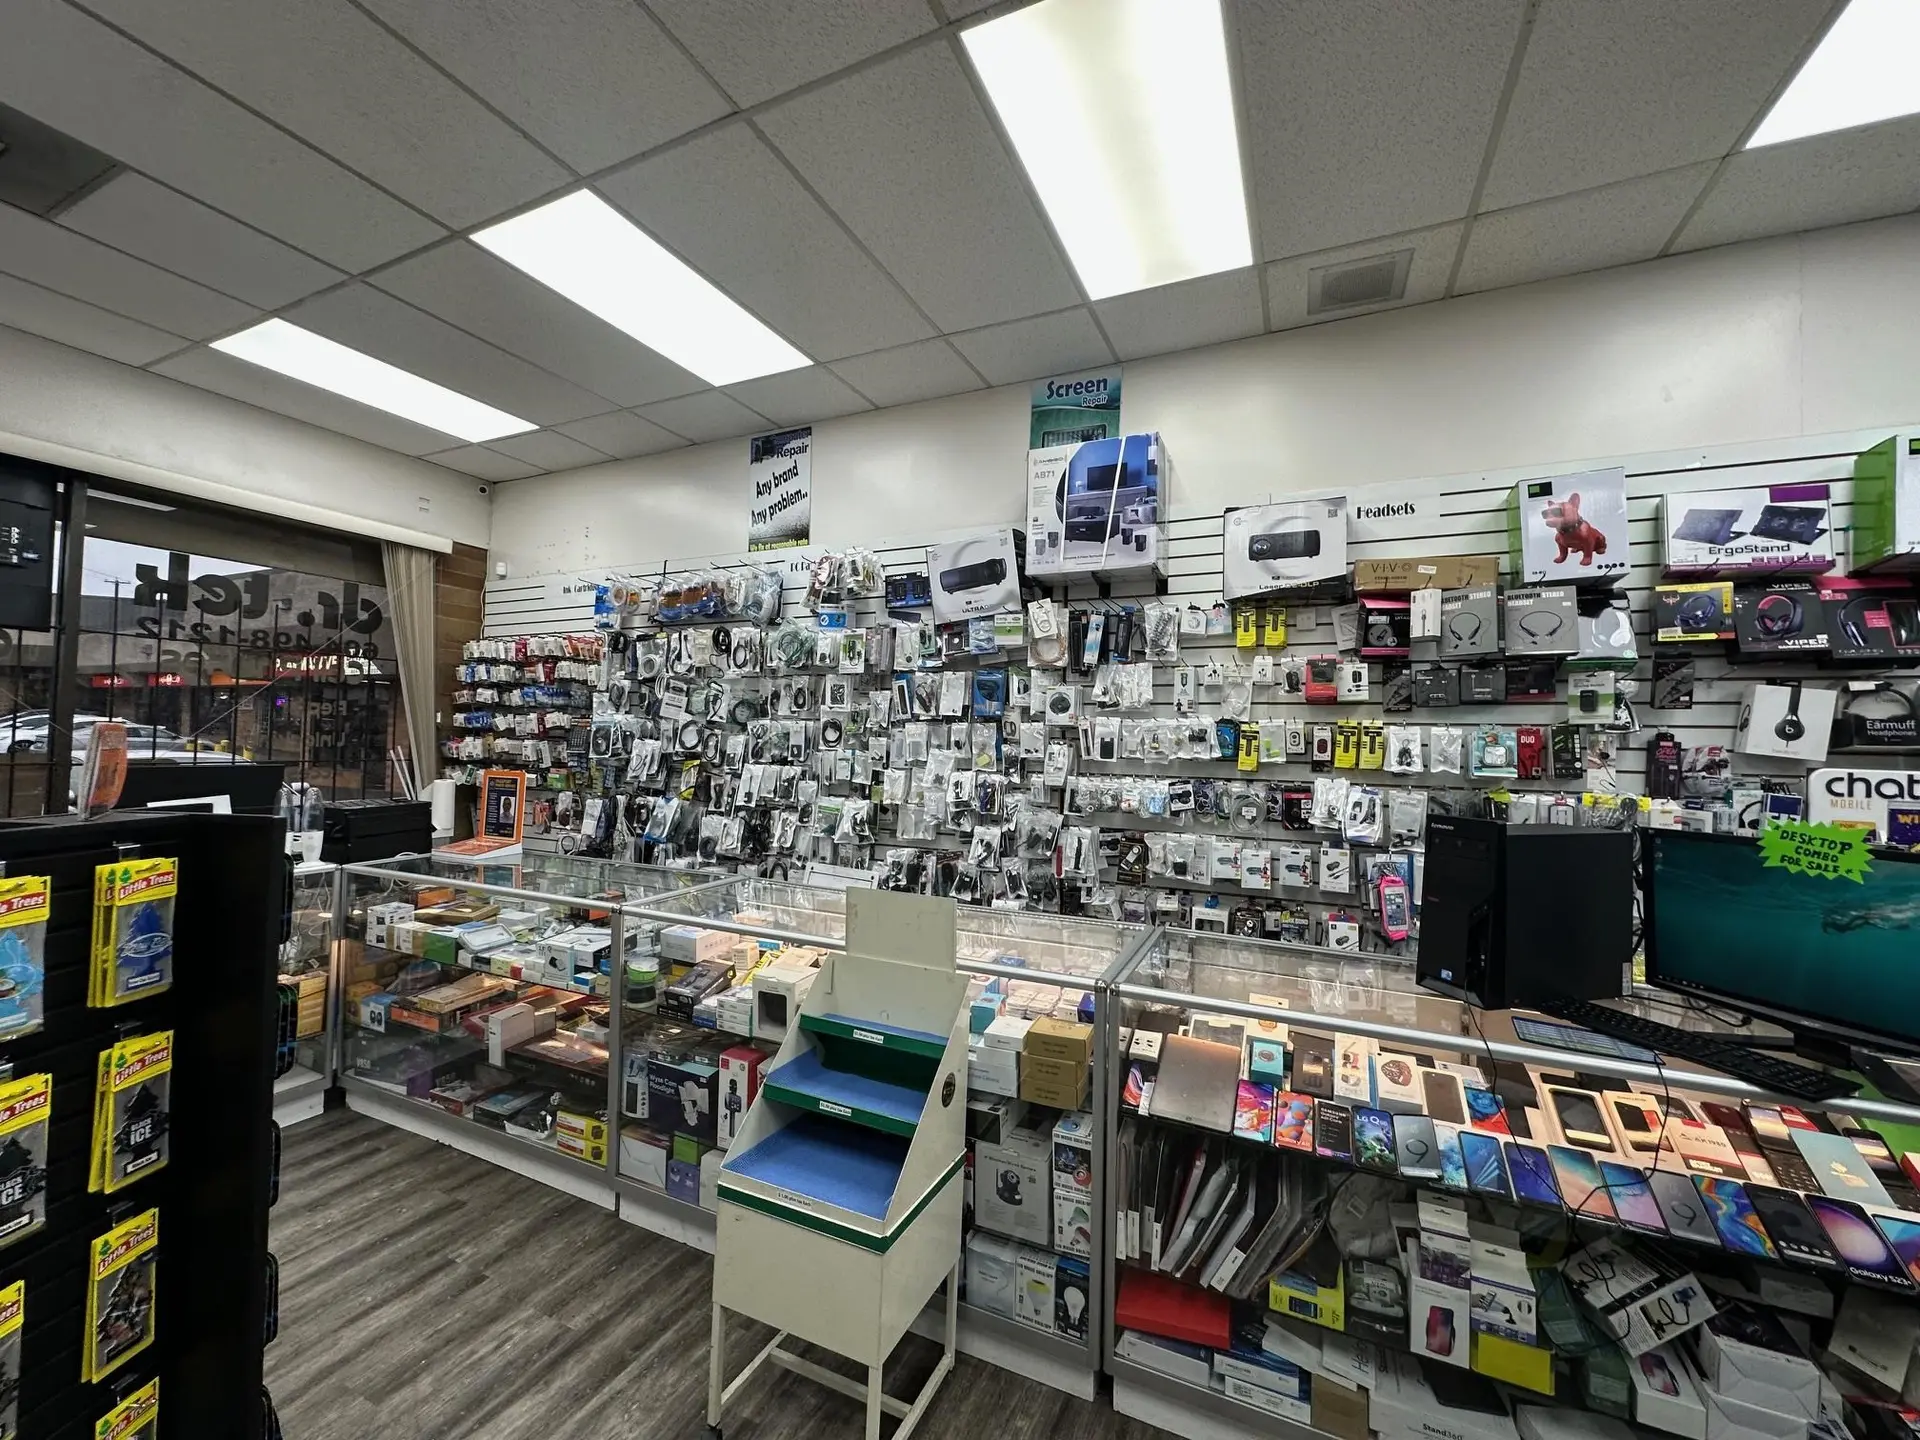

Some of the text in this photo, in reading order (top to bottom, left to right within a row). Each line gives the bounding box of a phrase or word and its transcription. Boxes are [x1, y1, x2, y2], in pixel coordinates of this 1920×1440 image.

[1046, 378, 1108, 400] Screen
[1082, 395, 1108, 407] Repair
[776, 442, 809, 459] Repair
[756, 460, 799, 499] Any brand
[1034, 470, 1055, 480] AB71
[751, 510, 767, 528] Any
[1356, 501, 1415, 520] Headsets
[1709, 543, 1791, 557] ErgoStand
[1469, 591, 1491, 600] STEREO
[1507, 599, 1534, 607] HEADSET
[962, 604, 985, 614] ULTRA
[1442, 602, 1462, 611] EADSET
[1520, 735, 1535, 744] DUO
[1830, 799, 1872, 811] MOBILE
[1780, 830, 1853, 855] DESKTOP
[1795, 845, 1839, 863] COMBO
[1780, 855, 1840, 874] FOR SALE
[119, 871, 174, 899] Little Trees
[11, 895, 44, 909] Trees
[115, 1046, 169, 1085] Little Trees
[13, 1094, 46, 1115] Trees
[0, 1176, 23, 1190] LACK
[0, 1184, 25, 1205] CE
[98, 1225, 155, 1273] Little Trees
[1850, 1266, 1888, 1282] Galaxy
